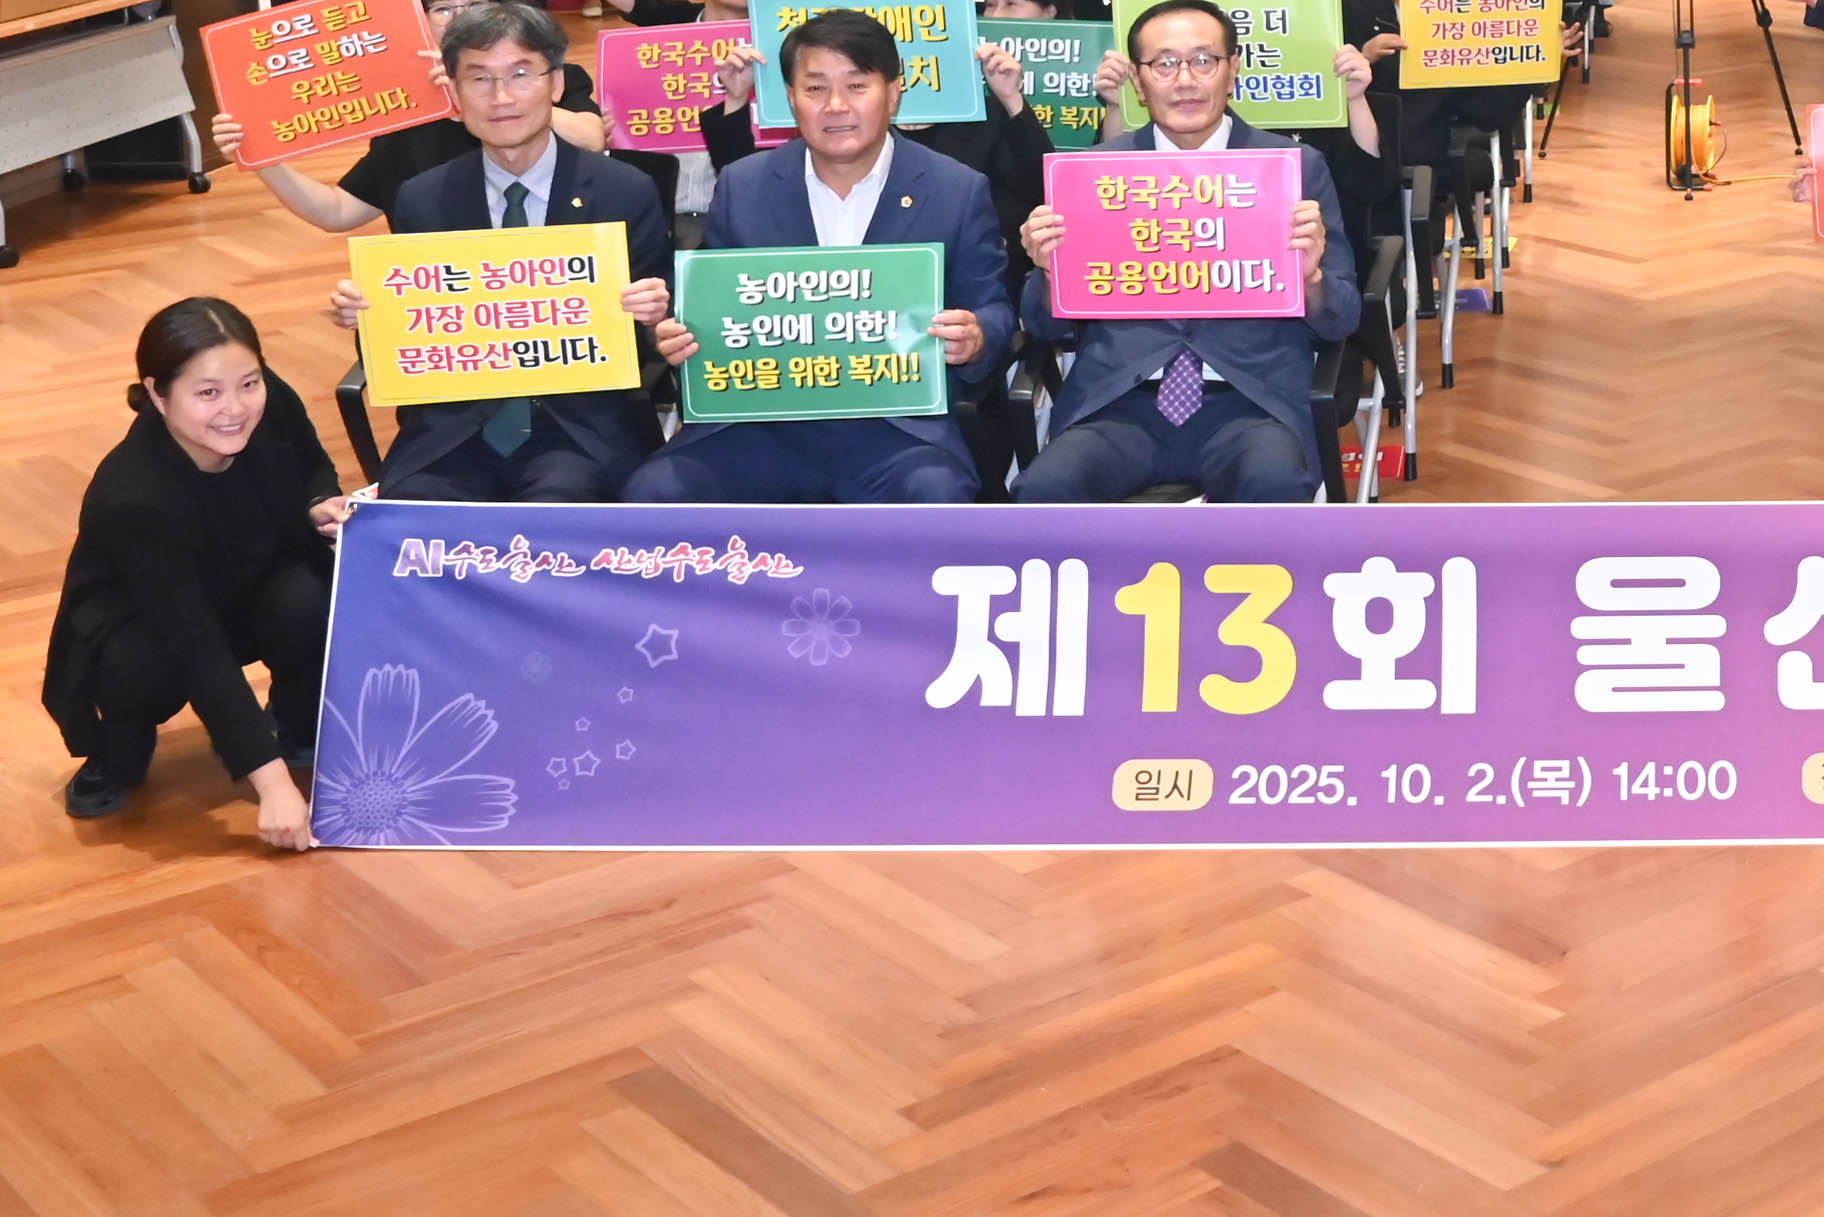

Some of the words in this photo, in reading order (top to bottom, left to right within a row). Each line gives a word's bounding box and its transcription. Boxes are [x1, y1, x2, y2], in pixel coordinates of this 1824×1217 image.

[249, 13, 319, 50] 눈으로
[322, 0, 371, 31] 듣고
[1265, 9, 1289, 35] 더
[1431, 21, 1466, 41] 가장
[1471, 19, 1540, 40] 아름다운
[246, 48, 315, 85] 손으로
[315, 30, 388, 65] 말하는
[1422, 43, 1547, 68] 문화유산입니다.
[291, 70, 361, 104] 우리는
[271, 87, 418, 142] 농아인입니다.
[1095, 174, 1257, 211] 한국수어는
[1129, 217, 1226, 253] 한국의
[384, 264, 472, 297] 수어는
[481, 255, 596, 292] 농아인의
[735, 269, 873, 306] 농아인의!
[1084, 259, 1285, 296] 공용언어이다.
[406, 305, 465, 335] 가장
[474, 295, 591, 331] 아름다운
[721, 313, 813, 349] 농인에
[825, 310, 898, 343] 의한!
[397, 336, 609, 376] 문화유산입니다.
[704, 357, 781, 392] 농인을
[789, 355, 841, 389] 위한
[848, 352, 921, 386] 복지!!
[925, 556, 1477, 717] 제13회
[1133, 768, 1194, 802] 일시
[1228, 763, 1358, 806] 2025.
[1380, 762, 1445, 807] 10.
[1466, 755, 1592, 809] 2.(목)
[1611, 758, 1738, 802] 14:00
